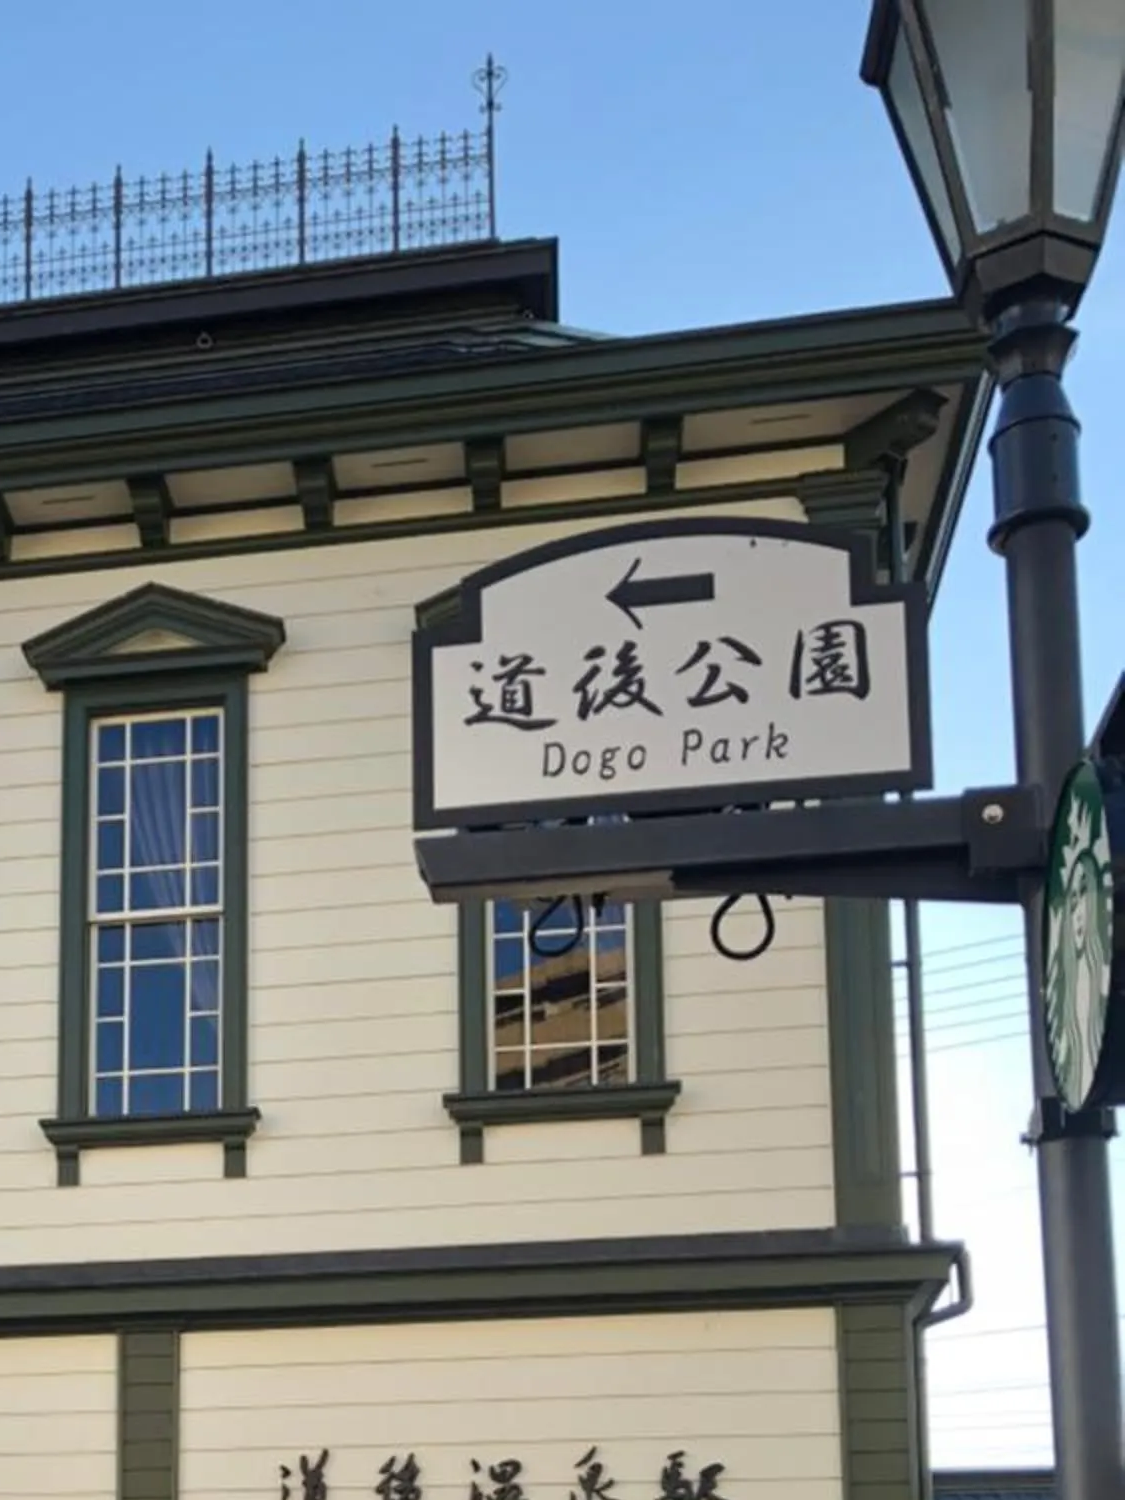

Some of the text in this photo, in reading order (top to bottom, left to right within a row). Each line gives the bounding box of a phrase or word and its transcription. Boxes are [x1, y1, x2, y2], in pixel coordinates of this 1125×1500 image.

[463, 619, 872, 732] 道後公園
[542, 722, 789, 780] Dogo Park
